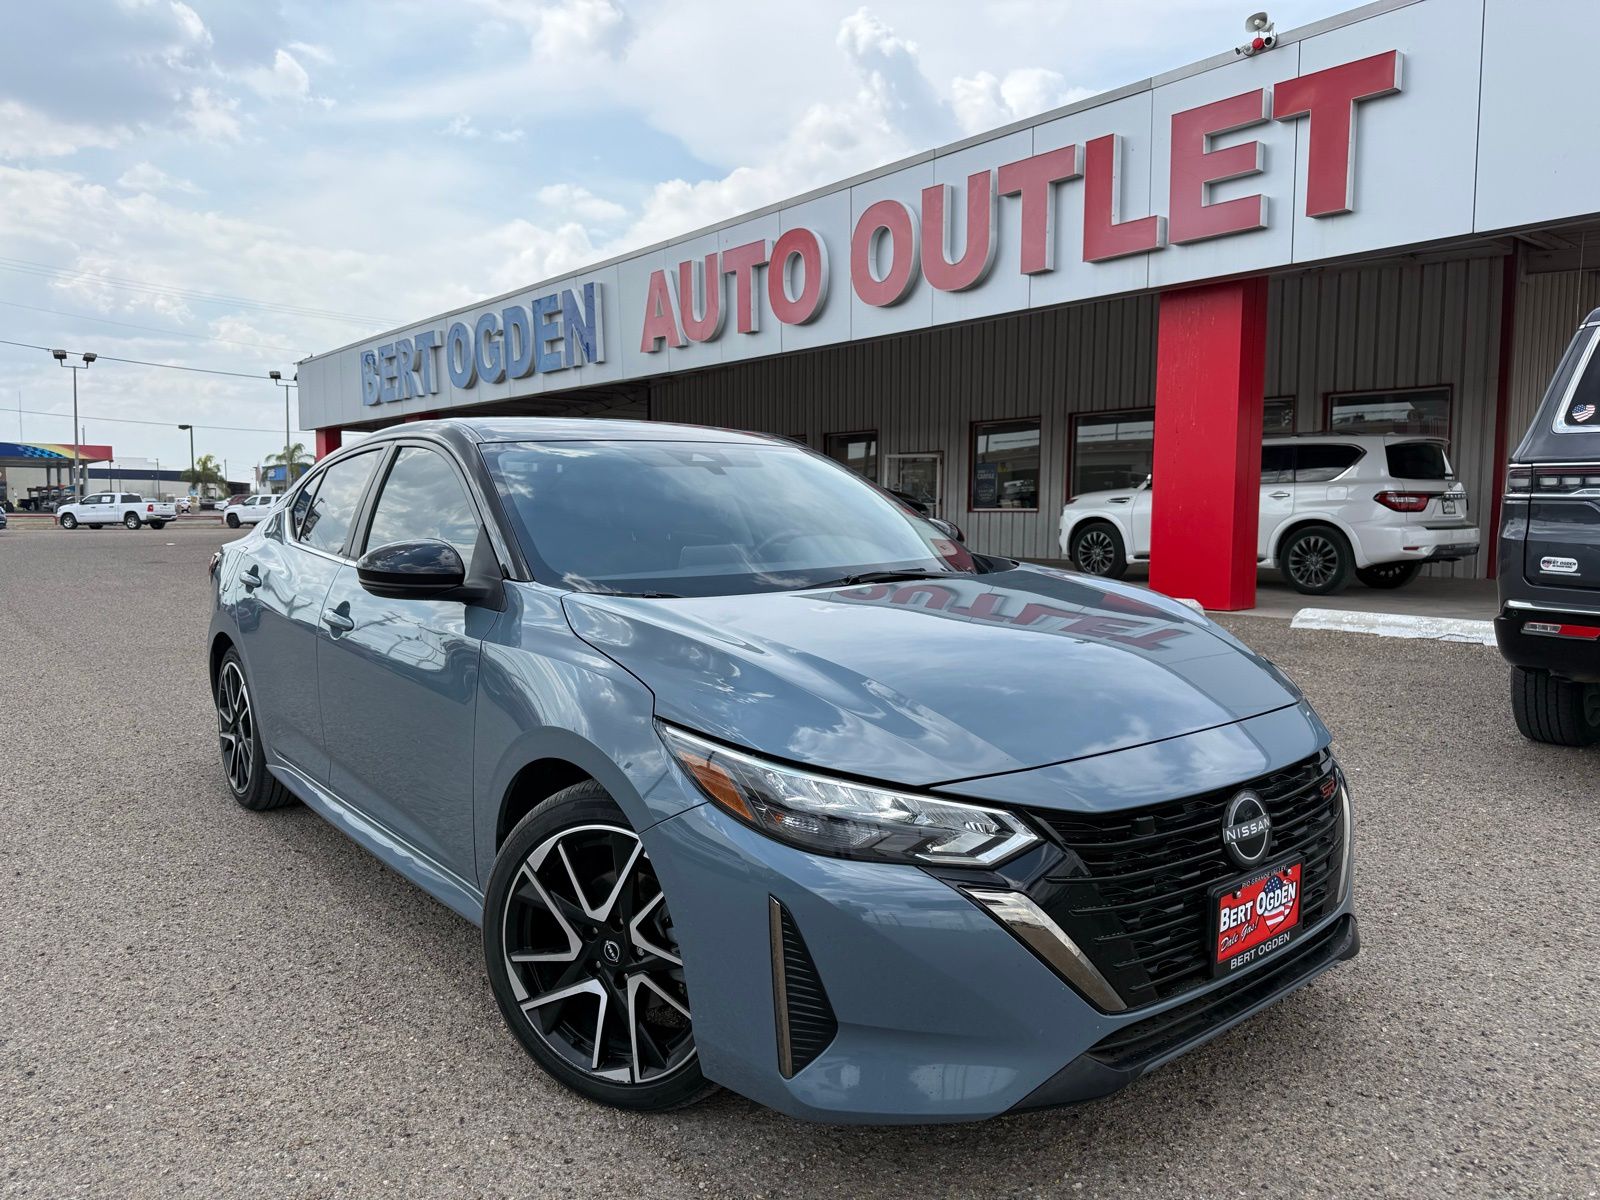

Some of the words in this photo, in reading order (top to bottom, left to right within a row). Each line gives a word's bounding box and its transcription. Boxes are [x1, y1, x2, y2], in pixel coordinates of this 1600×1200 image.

[640, 228, 829, 353] AUTO
[851, 49, 1404, 307] OUTLET
[361, 330, 441, 406] BERT
[447, 282, 604, 389] OGDEN
[1226, 816, 1269, 841] NISSAN
[1220, 901, 1253, 932] BERT
[1256, 881, 1296, 915] OGDEN
[1230, 948, 1257, 970] BERT
[1257, 931, 1290, 956] OGDEN
